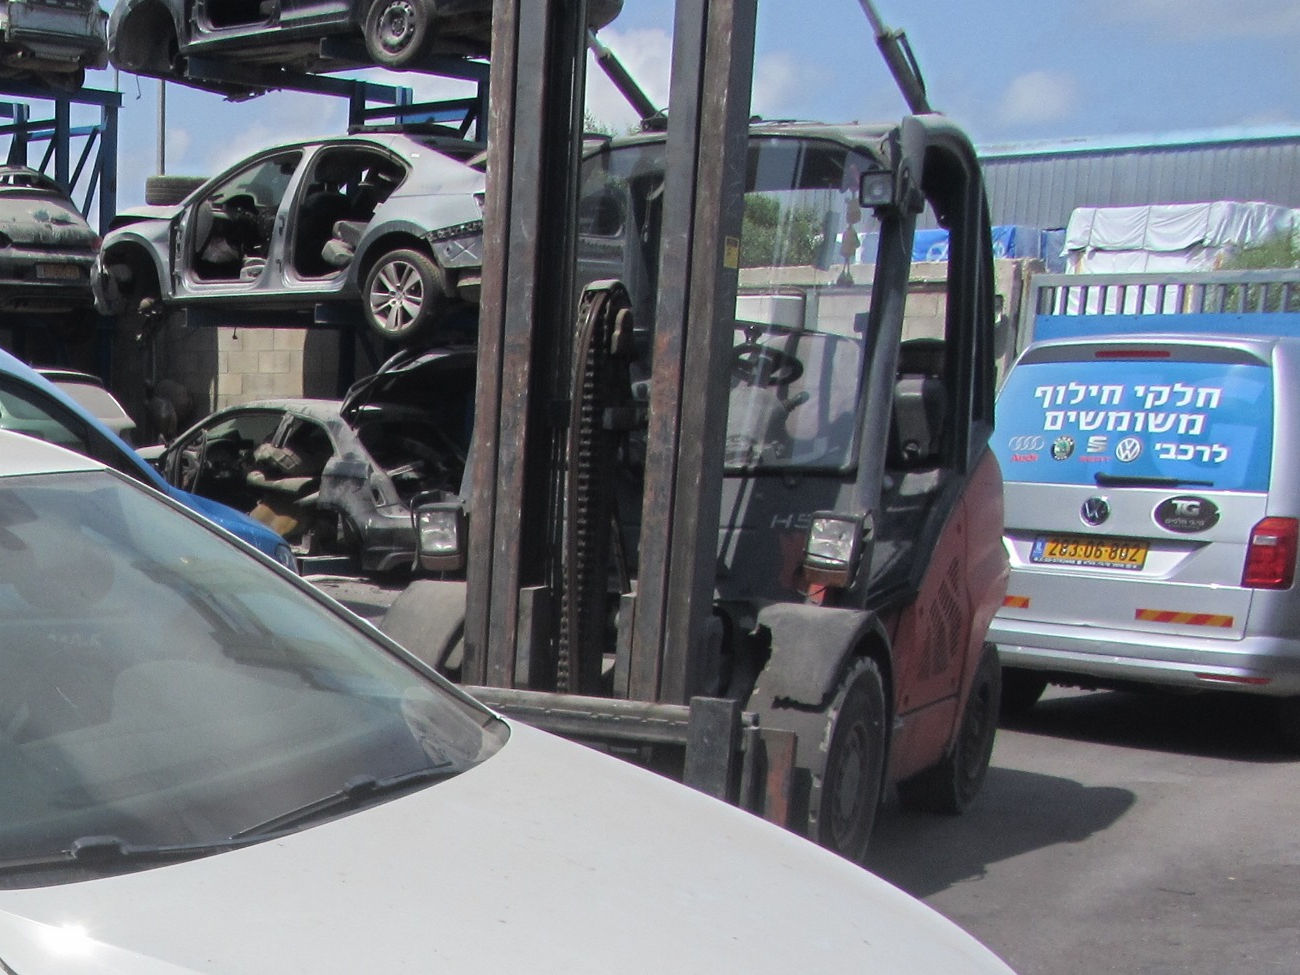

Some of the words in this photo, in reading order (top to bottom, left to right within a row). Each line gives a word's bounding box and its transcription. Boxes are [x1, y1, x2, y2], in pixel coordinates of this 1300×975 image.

[1034, 382, 1125, 408] חילוף
[1134, 383, 1223, 409] חלקי
[1043, 410, 1205, 435] משומשים
[1154, 442, 1228, 463] לרכבי
